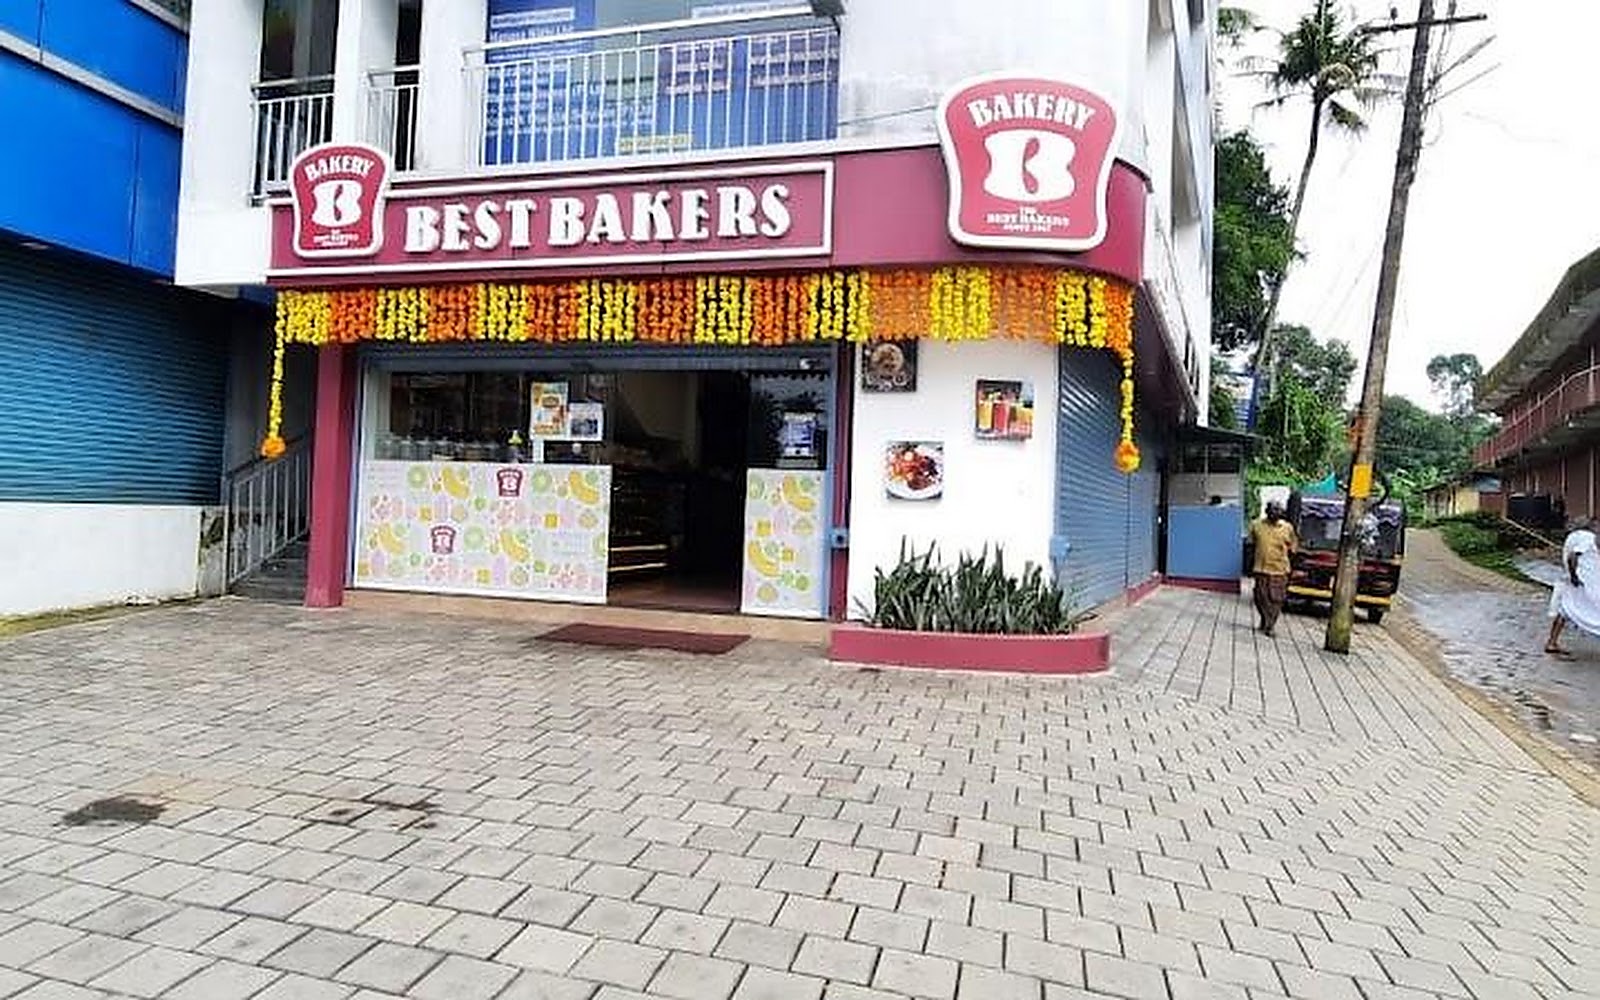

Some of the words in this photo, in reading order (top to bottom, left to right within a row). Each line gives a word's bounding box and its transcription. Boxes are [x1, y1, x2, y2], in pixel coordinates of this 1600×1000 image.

[966, 92, 1096, 131] BAKERY
[304, 154, 375, 181] BAKERY
[404, 199, 537, 252] BEST
[547, 184, 791, 246] BAKERS
